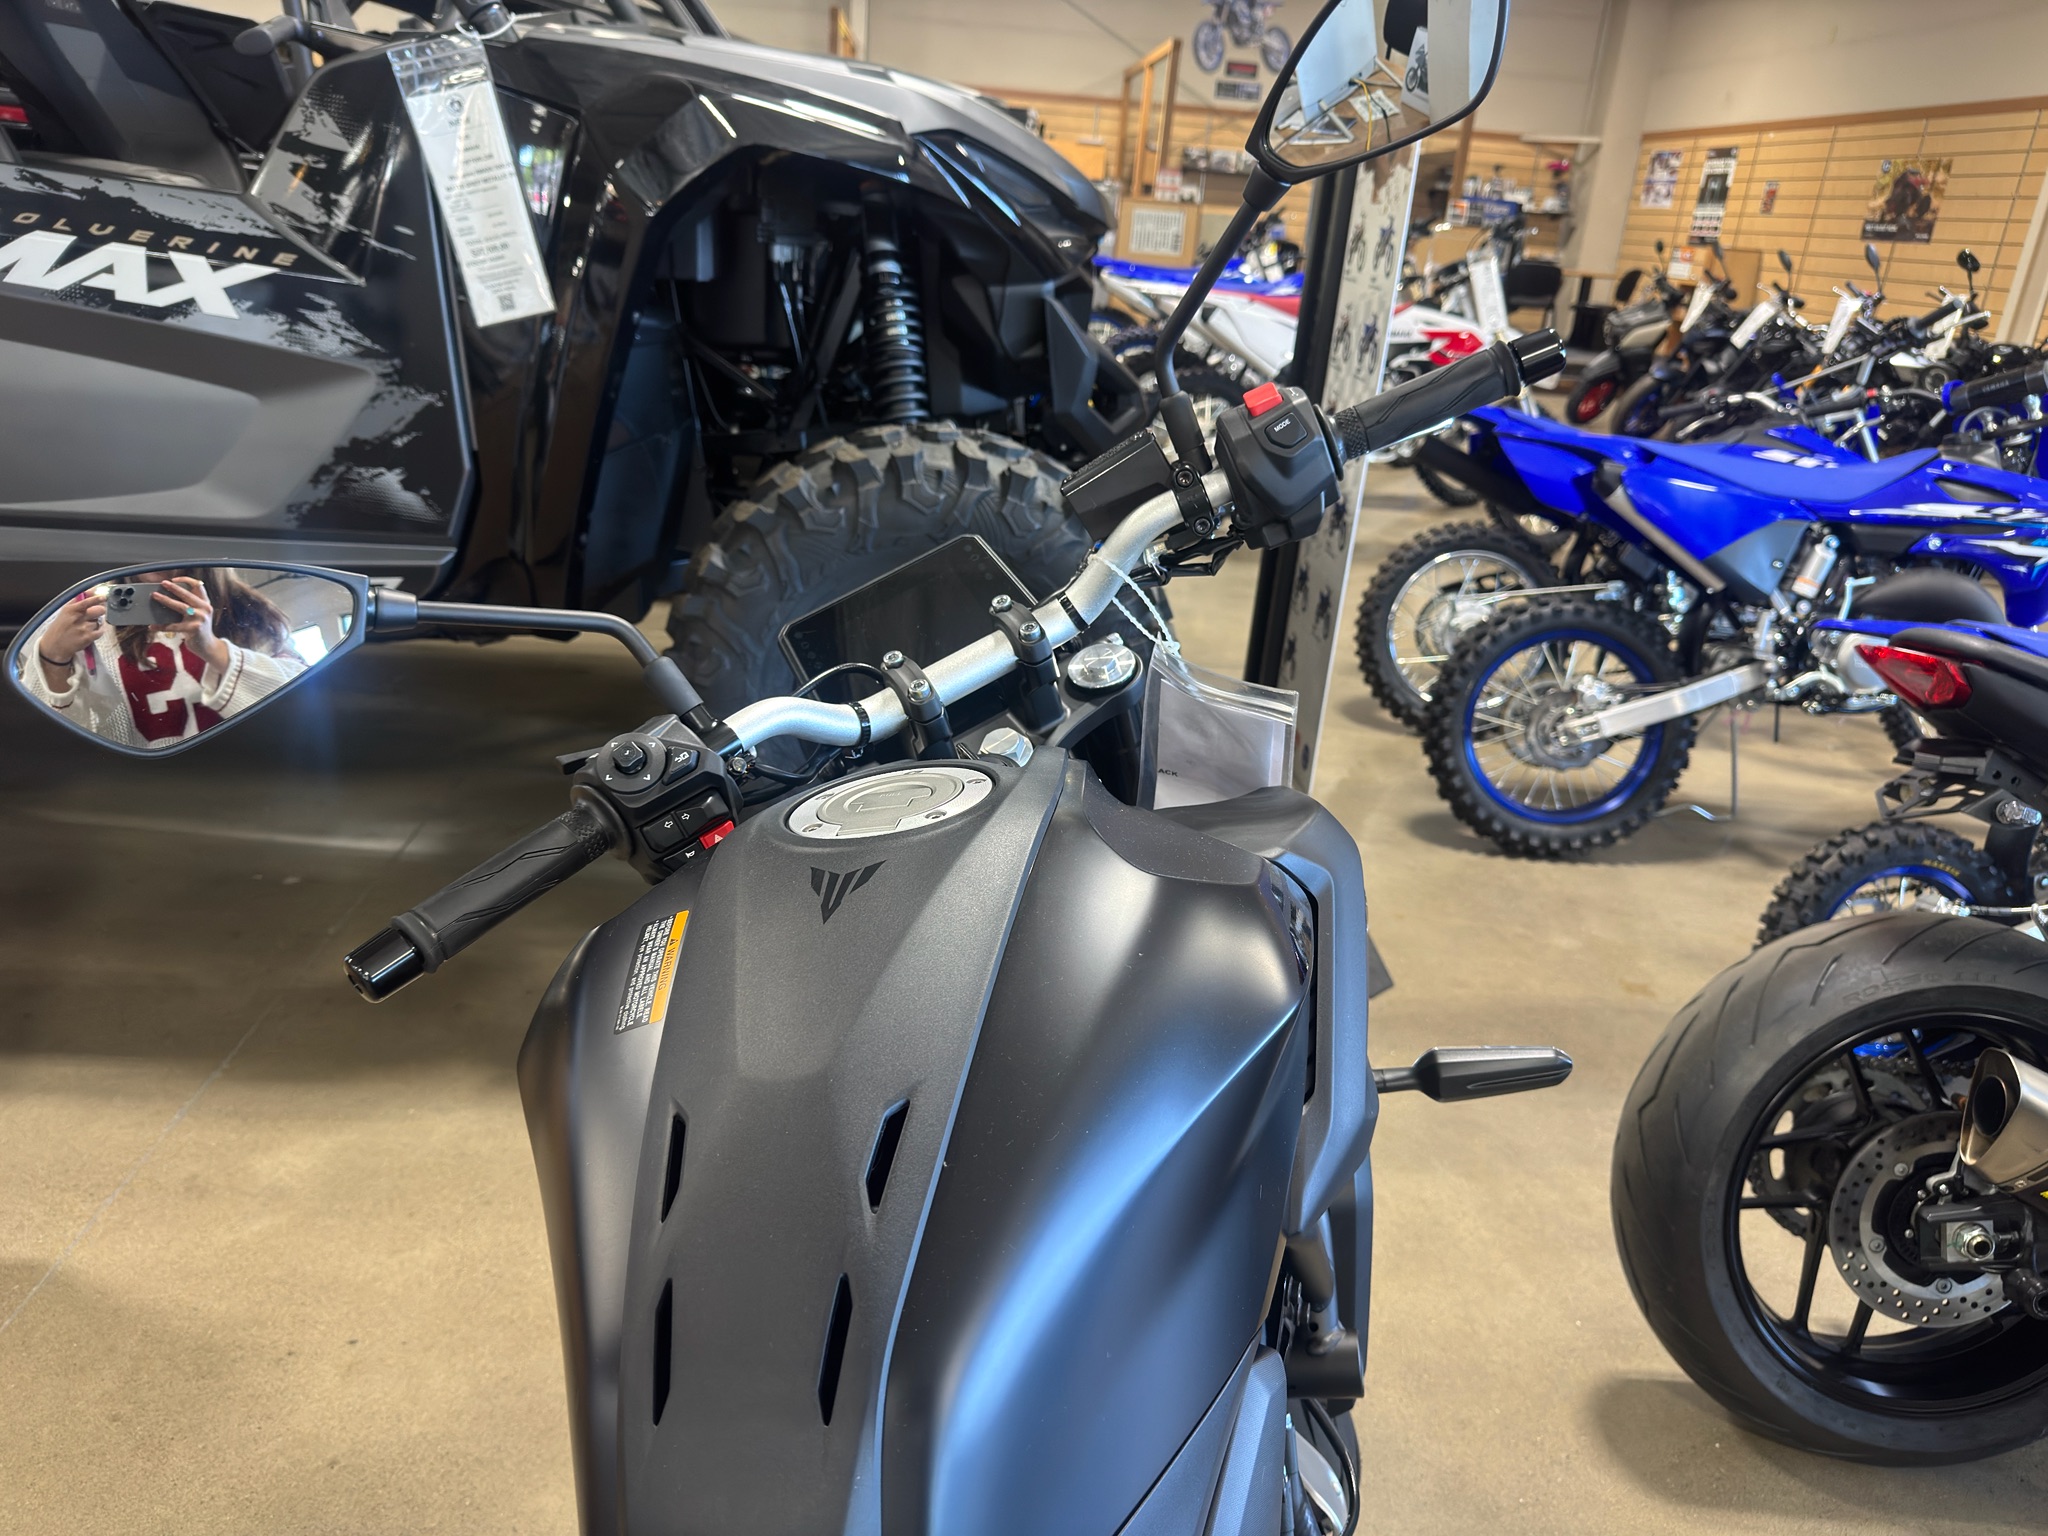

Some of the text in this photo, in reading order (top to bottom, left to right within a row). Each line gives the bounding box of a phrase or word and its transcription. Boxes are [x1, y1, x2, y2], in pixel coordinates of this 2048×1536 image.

[11, 211, 299, 267] OLVERINE
[1273, 418, 1291, 432] MODE
[659, 920, 667, 930] THE
[663, 918, 674, 936] BEFORE
[645, 941, 655, 955] WEAR
[660, 936, 669, 947] YOU
[654, 948, 666, 970] OPERATE
[651, 970, 660, 982] THIS
[658, 946, 677, 991] WARNING
[635, 964, 648, 990] APPROVED
[644, 973, 652, 985] AND
[641, 986, 649, 996] ALL
[627, 991, 640, 1026] MOTORCYCLE
[642, 1007, 651, 1023] READ
